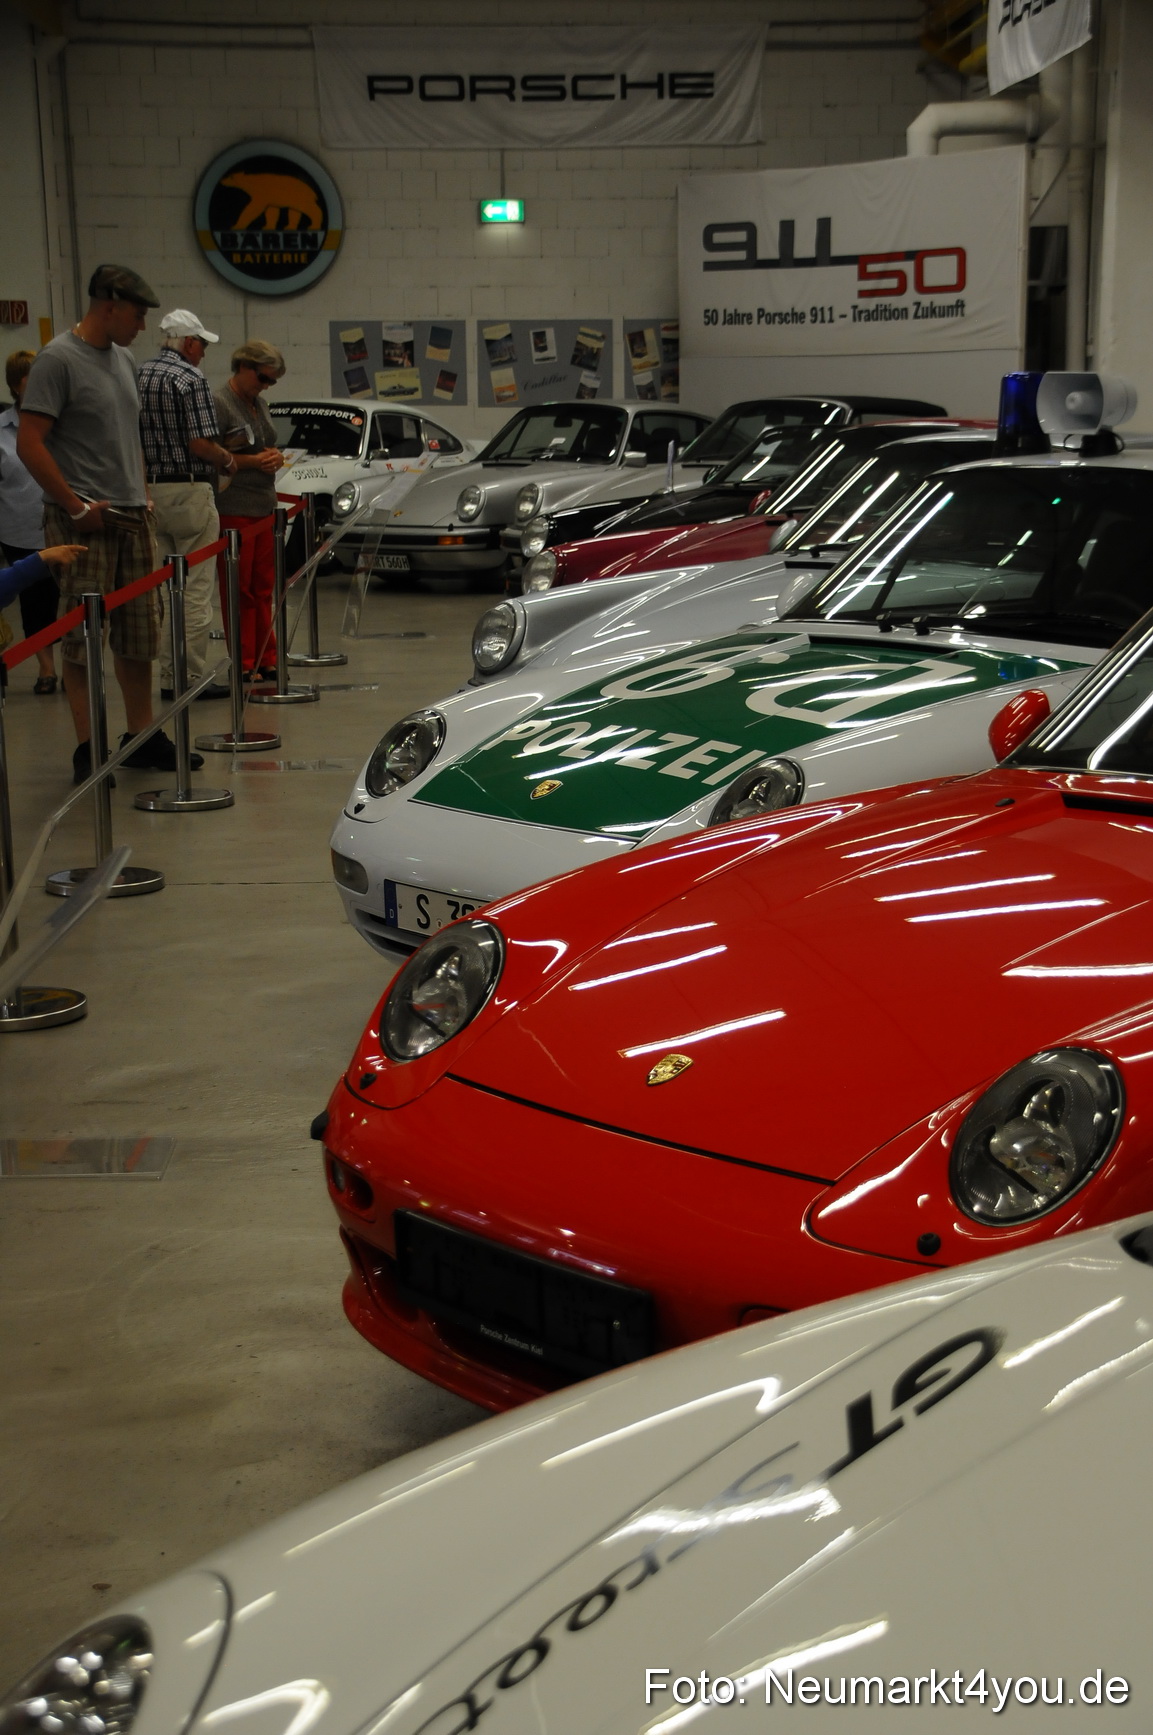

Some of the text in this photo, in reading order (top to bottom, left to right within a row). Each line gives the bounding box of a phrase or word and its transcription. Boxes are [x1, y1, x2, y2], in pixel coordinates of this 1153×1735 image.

[367, 73, 714, 101] PORSCHE
[220, 232, 318, 249] BÄREN
[703, 217, 831, 271] 911
[231, 252, 308, 264] BATTERIE
[857, 247, 966, 298] 50
[703, 309, 718, 326] 50
[721, 309, 753, 326] Jahre
[757, 307, 805, 325] Porsche
[810, 306, 834, 324] 911
[851, 302, 908, 323] Tradition
[912, 299, 965, 320] Zukunft
[290, 407, 356, 420] MOTORSPORT
[480, 720, 767, 786] POLIZEI
[822, 1325, 1006, 1478] GT
